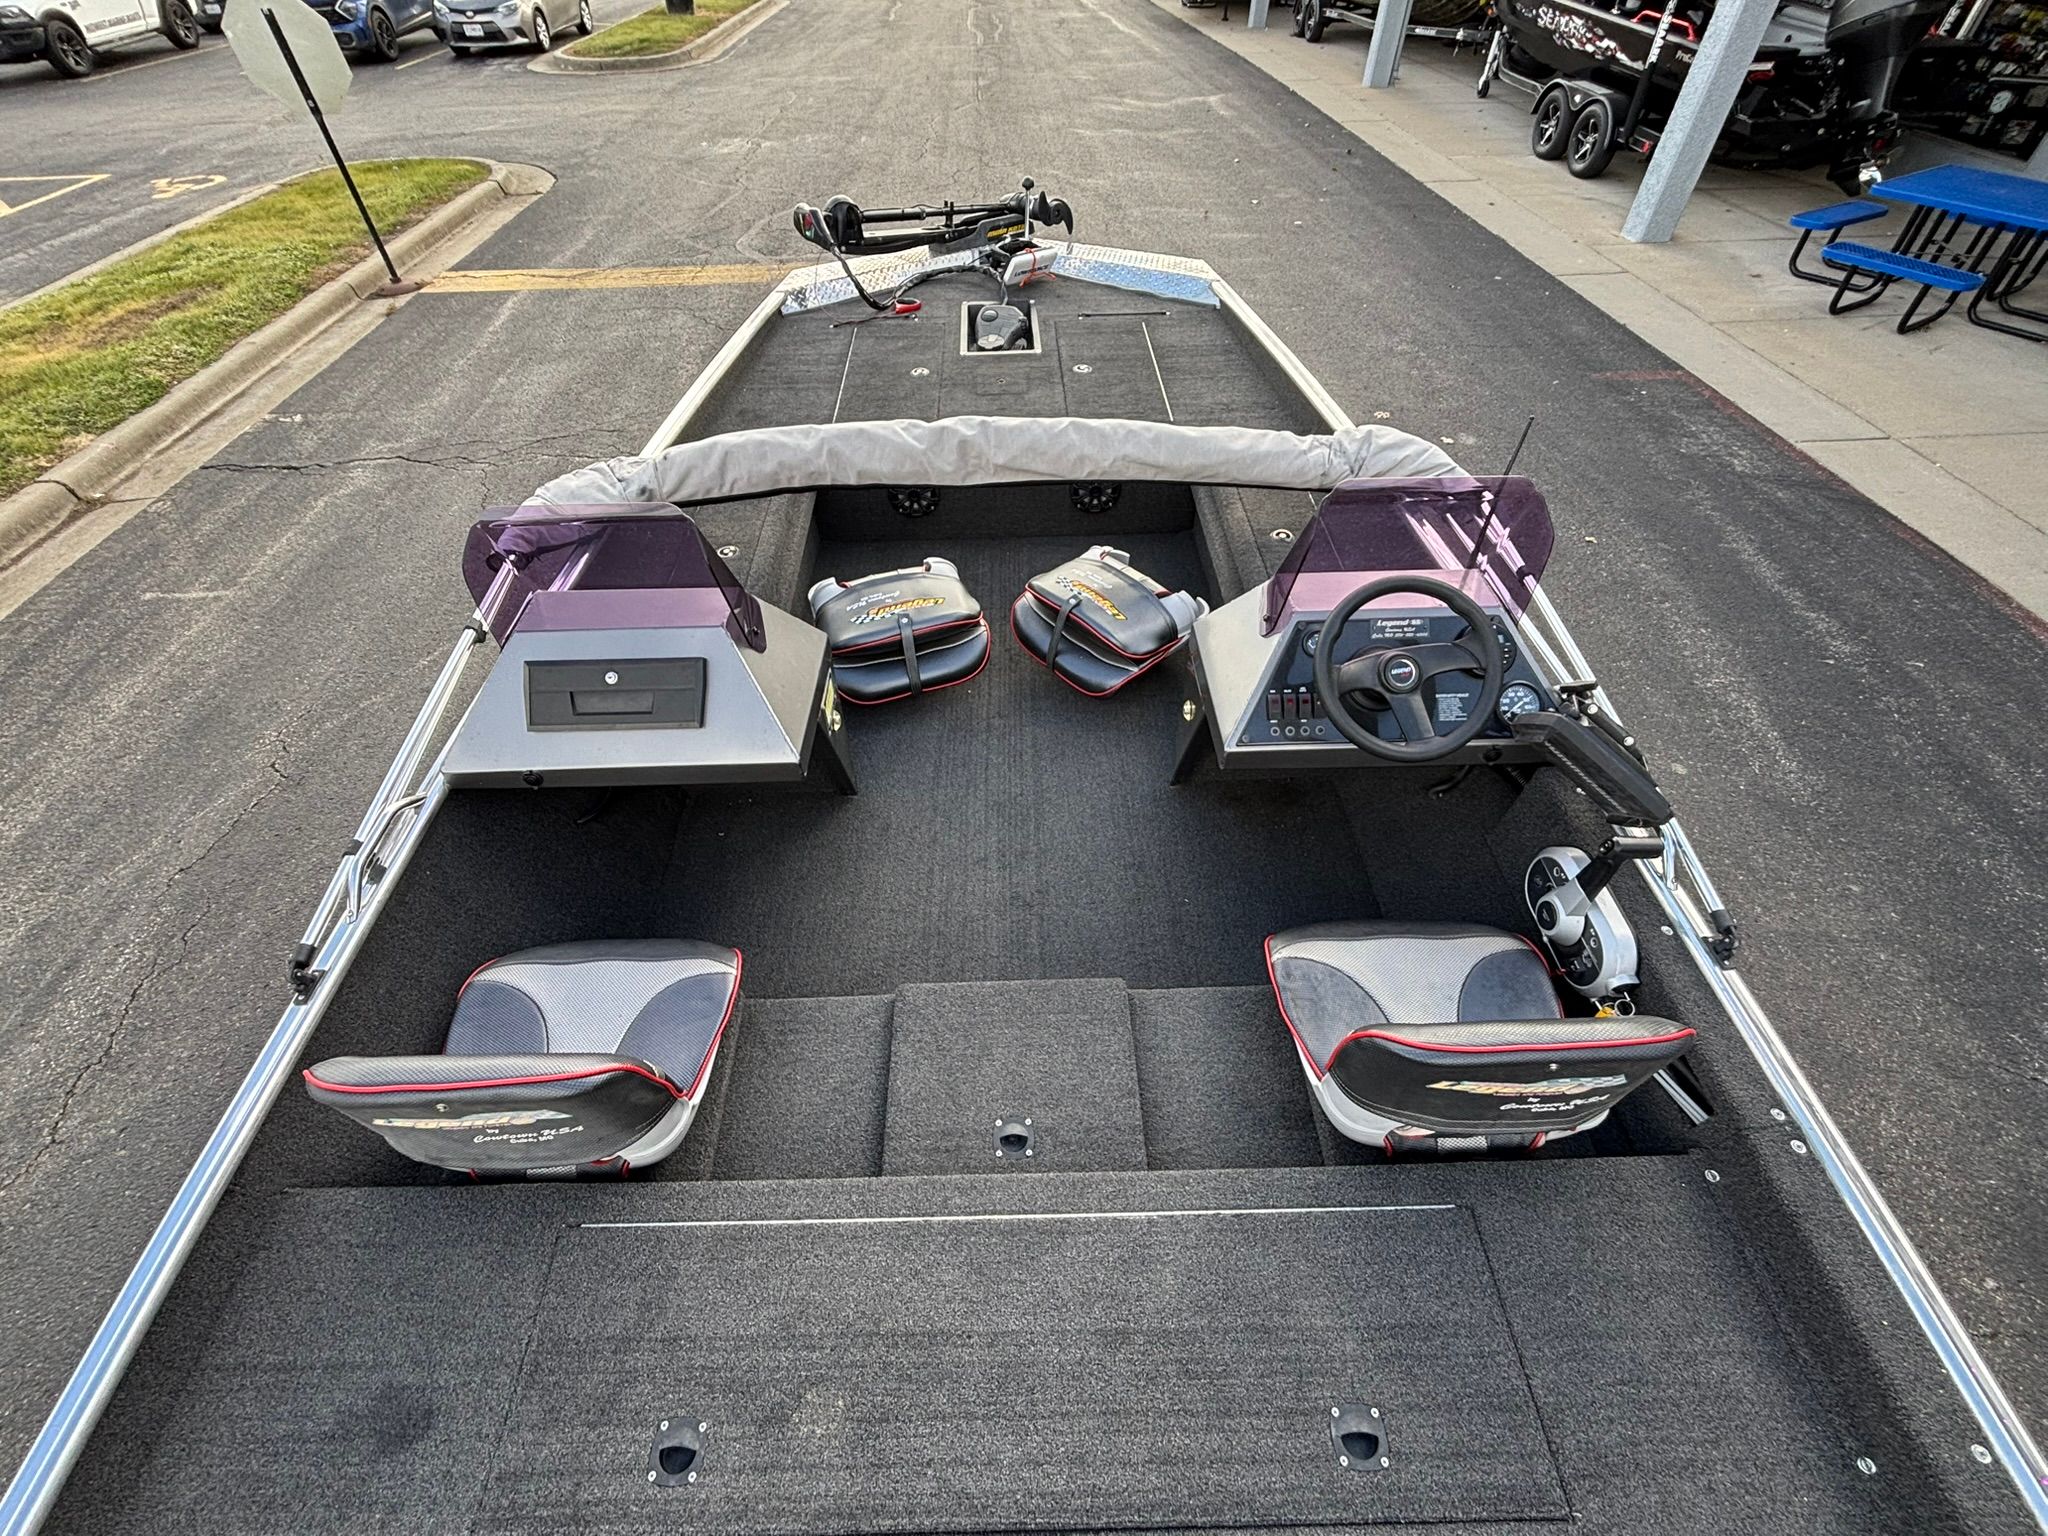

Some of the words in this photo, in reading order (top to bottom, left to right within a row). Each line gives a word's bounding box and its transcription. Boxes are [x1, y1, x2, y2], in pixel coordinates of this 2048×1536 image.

[1376, 619, 1410, 627] Legend
[473, 1132, 539, 1144] Cowtown
[540, 1125, 584, 1136] USA
